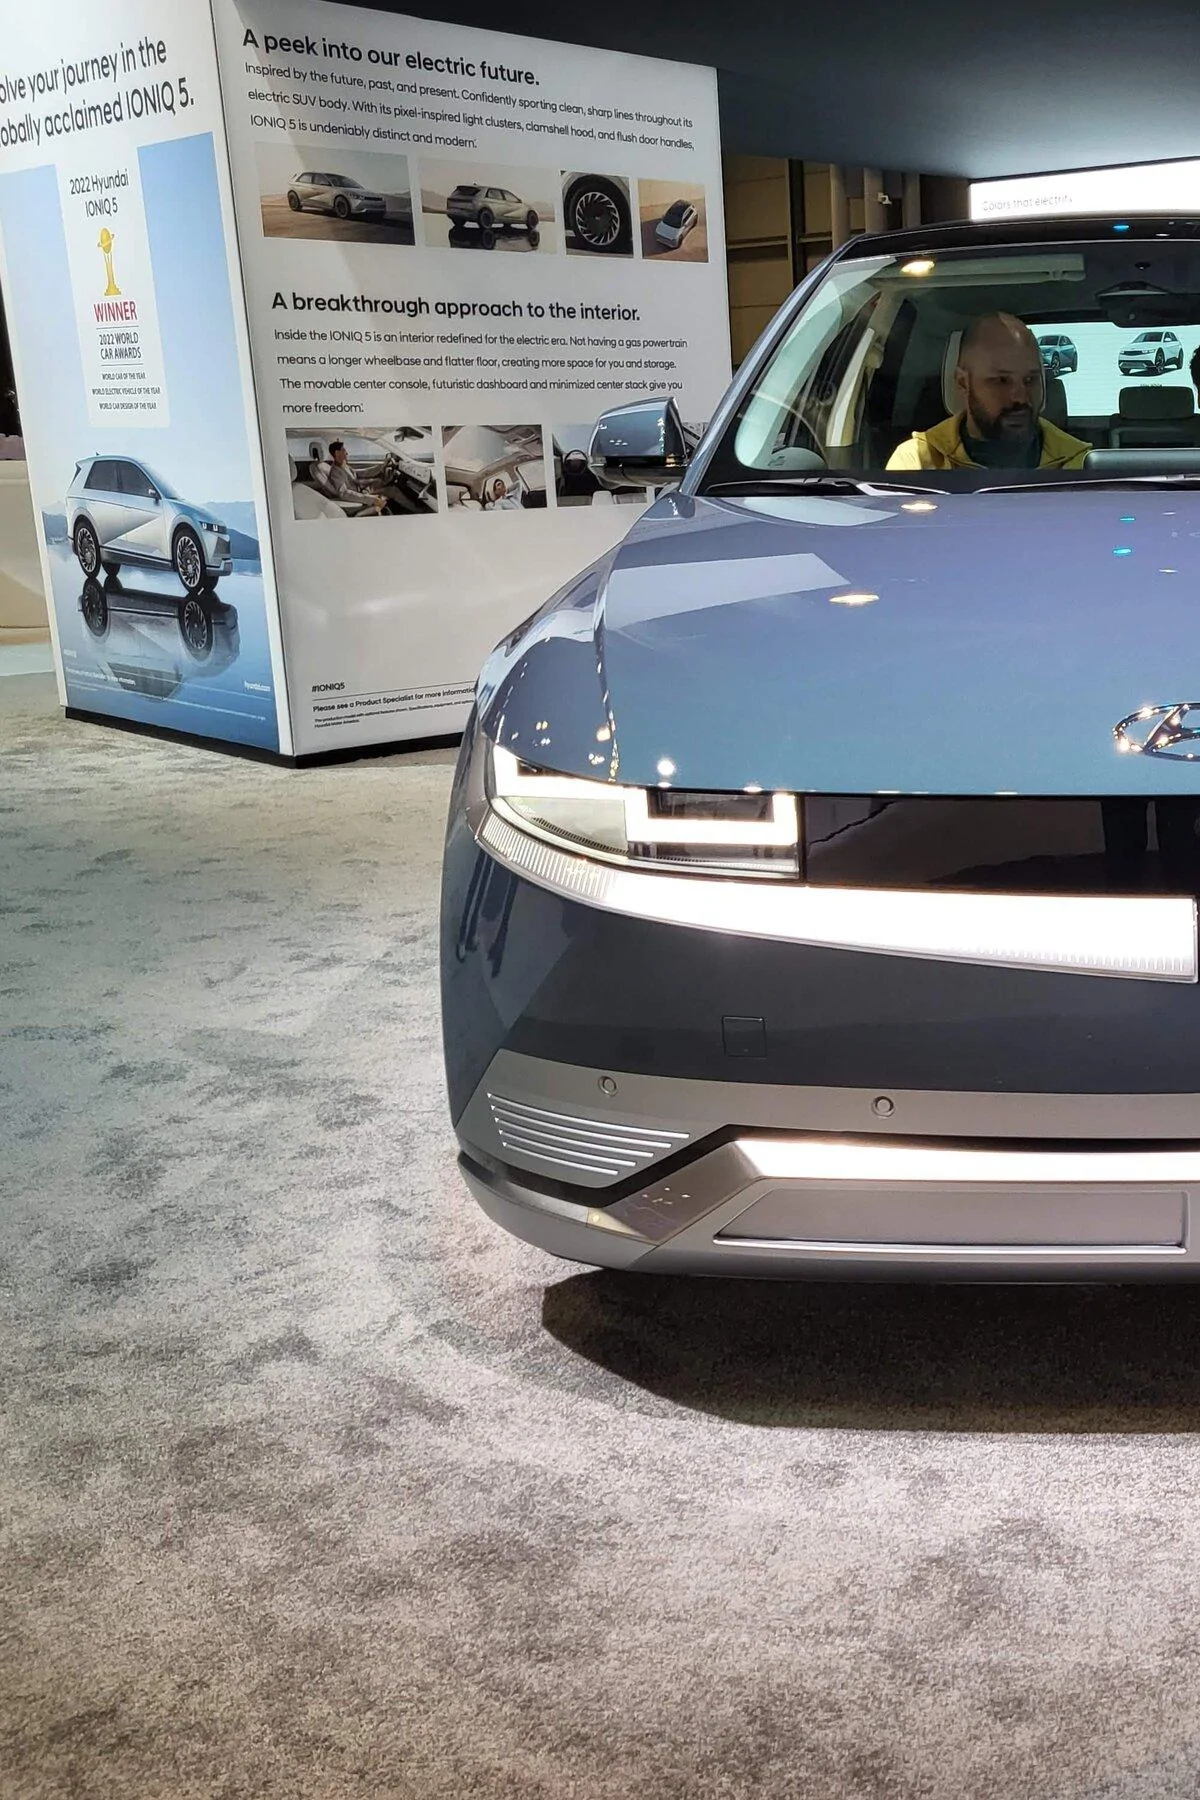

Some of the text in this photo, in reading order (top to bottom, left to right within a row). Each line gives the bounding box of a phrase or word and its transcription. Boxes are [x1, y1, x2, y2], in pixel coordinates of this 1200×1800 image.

[243, 29, 539, 85] A peek into our electric future.
[28, 68, 58, 102] your
[61, 51, 118, 94] journey
[121, 42, 136, 73] in
[139, 36, 166, 67] the
[245, 62, 692, 128] Inspired by the future, past, and present. Confidently sporting clean, sharp lines throughout its
[0, 77, 194, 147] obally acclaimed IONIQ 5.
[248, 90, 694, 150] electric SUV body. With its pixel-inspired light clusters, clamshell hood, and flush door handles,
[251, 115, 286, 130] IONIQ
[289, 120, 296, 130] 5
[299, 120, 307, 131] is
[310, 124, 370, 139] undeniably
[373, 128, 410, 142] distinct
[413, 132, 432, 144] and
[70, 168, 128, 194] 2022 Hyundai
[85, 197, 118, 217] IONIQ 5
[94, 301, 137, 322] WINNER
[272, 292, 640, 321] A breakthrough approach to the interior.
[99, 332, 138, 345] 2022 WORLD
[274, 330, 307, 340] Inside
[310, 331, 327, 340] the
[330, 331, 363, 343] IONIQ
[365, 332, 371, 341] 5
[374, 332, 382, 342] is
[384, 334, 397, 342] an
[400, 332, 434, 343] interior
[436, 334, 482, 344] redefined
[485, 334, 497, 344] for
[500, 334, 515, 345] the
[517, 335, 549, 345] electric
[570, 337, 586, 346] Not
[588, 338, 617, 348] having
[626, 340, 641, 348] gas
[643, 339, 687, 349] powertrain
[101, 347, 141, 360] CAR AWARDS
[277, 356, 316, 365] means
[329, 354, 362, 367] longer
[365, 356, 421, 366] wheelbase
[423, 356, 442, 366] and
[445, 356, 474, 366] flatter
[477, 357, 500, 368] floor,
[502, 358, 540, 369] creating
[542, 359, 565, 367] more
[567, 360, 593, 369] space
[595, 358, 606, 368] for
[609, 360, 624, 370] you
[626, 359, 642, 368] and
[644, 360, 676, 369] storage.
[280, 378, 682, 391] The movable center console, futuristic dashboard and minimized center stack give you
[283, 403, 312, 412] more
[312, 682, 345, 692] #IONIQ5
[383, 694, 414, 704] Specialist
